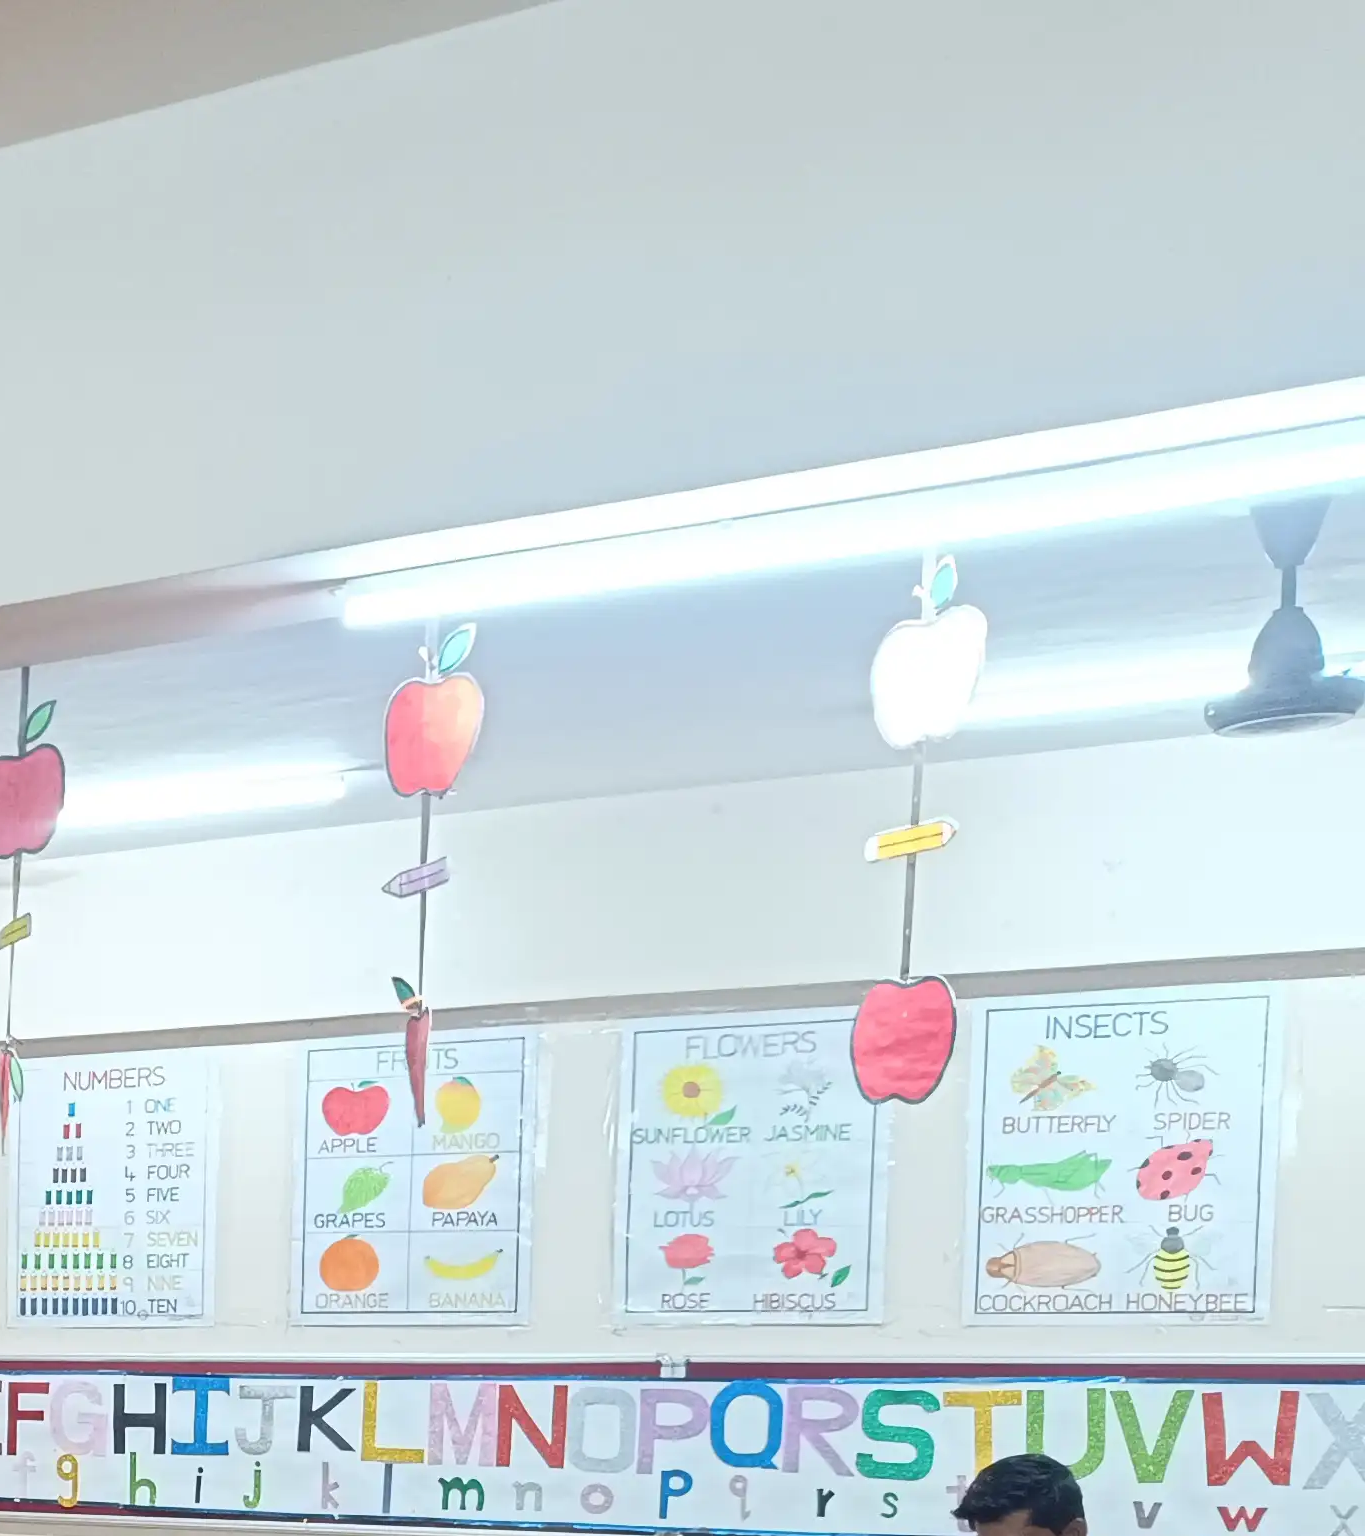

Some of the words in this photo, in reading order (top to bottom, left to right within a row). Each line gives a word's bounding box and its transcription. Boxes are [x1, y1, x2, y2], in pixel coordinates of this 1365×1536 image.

[1046, 1010, 1169, 1040] INSECTS
[685, 1030, 818, 1060] FLOWERS
[63, 1066, 166, 1091] NUMBERS
[144, 1097, 177, 1113] ONE
[125, 1122, 135, 1137] 2
[147, 1120, 182, 1135] TWO
[1002, 1114, 1117, 1134] BUTTERFLY
[1153, 1112, 1231, 1131] SPIDER
[432, 1132, 500, 1150] MANGO
[631, 1126, 751, 1145] SUNFLOWER
[764, 1123, 852, 1142] JASMINE
[126, 1145, 136, 1159] 3
[147, 1142, 195, 1158] THREE
[318, 1137, 378, 1154] APPLE
[124, 1165, 136, 1181] 4
[147, 1164, 191, 1180] FOUR
[125, 1188, 136, 1203] 5
[147, 1187, 180, 1202] FIVE
[124, 1211, 135, 1225] 6
[146, 1209, 171, 1225] SIX
[313, 1213, 386, 1229] GRAPES
[431, 1211, 498, 1228] PAPAYA
[653, 1210, 715, 1229] LOTUS
[783, 1209, 823, 1227] LILY
[981, 1204, 1124, 1224] GRASSHOPPER
[1168, 1204, 1214, 1223] BUG
[123, 1232, 135, 1247] 7
[147, 1231, 198, 1248] SEVEN
[122, 1255, 133, 1270] 8
[147, 1253, 190, 1269] EIGHT
[122, 1278, 133, 1293] 9
[147, 1275, 183, 1291] NINE
[120, 1299, 137, 1315] 10
[148, 1298, 177, 1314] TEN
[314, 1293, 389, 1310] ORANGE
[429, 1291, 506, 1308] BANANA
[661, 1293, 710, 1310] ROSE
[753, 1293, 836, 1311] HIBISCUS
[978, 1293, 1113, 1312] COCKROACH
[1126, 1292, 1249, 1312] HONEYBEE
